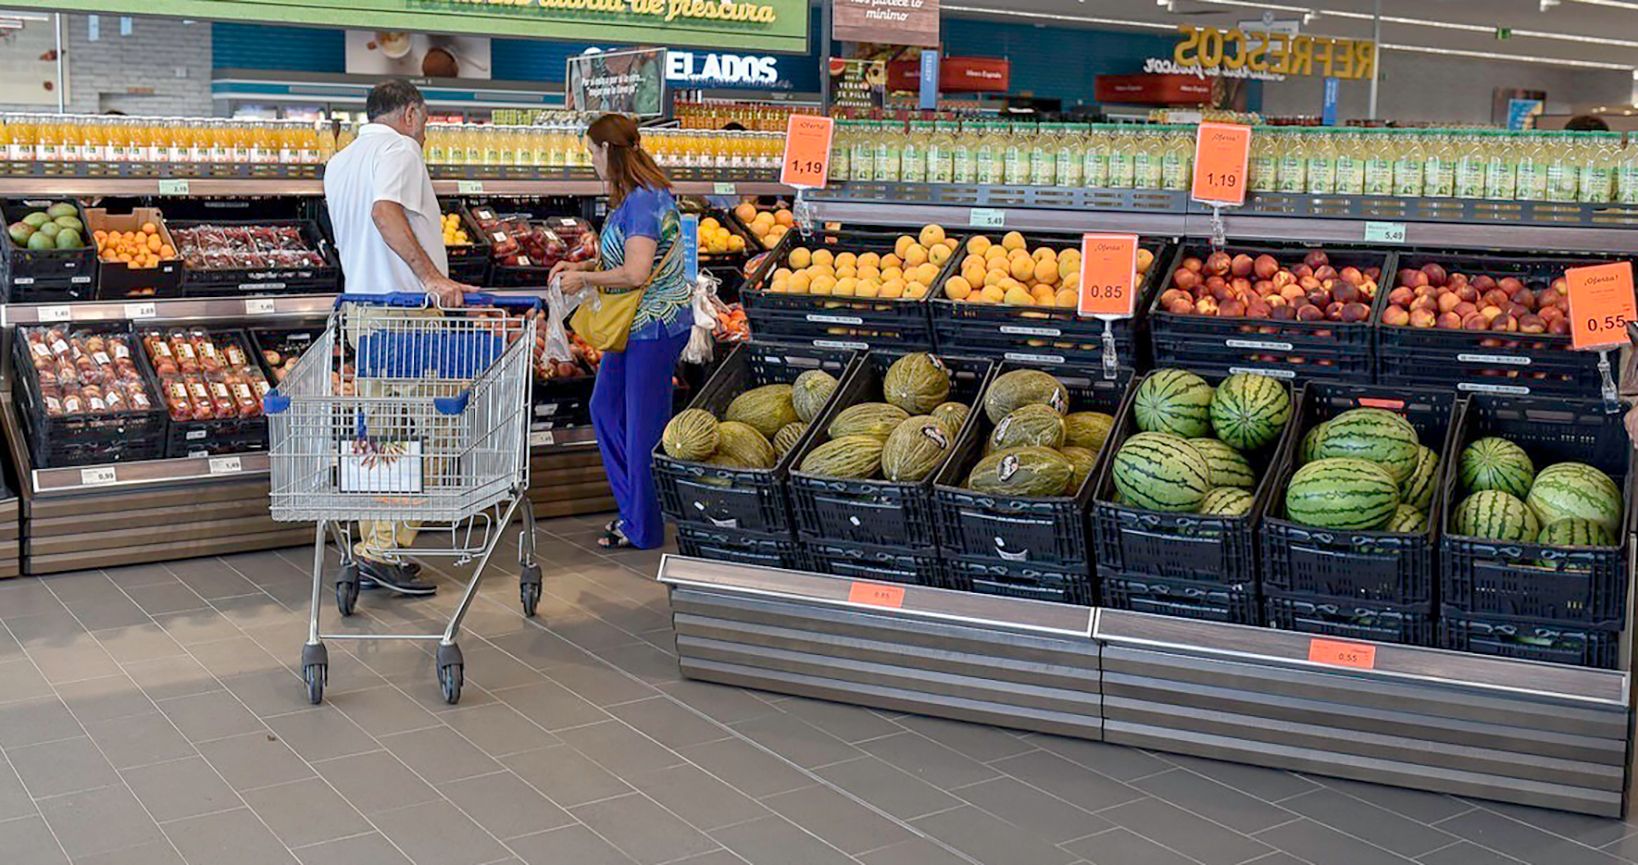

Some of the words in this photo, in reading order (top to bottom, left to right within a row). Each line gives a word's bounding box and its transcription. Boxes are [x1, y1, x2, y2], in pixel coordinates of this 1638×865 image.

[866, 8, 909, 21] mínimo
[792, 160, 822, 174] 1,19
[1208, 172, 1236, 187] 1,19
[1385, 231, 1404, 240] 5,49
[1587, 314, 1626, 333] 0,55
